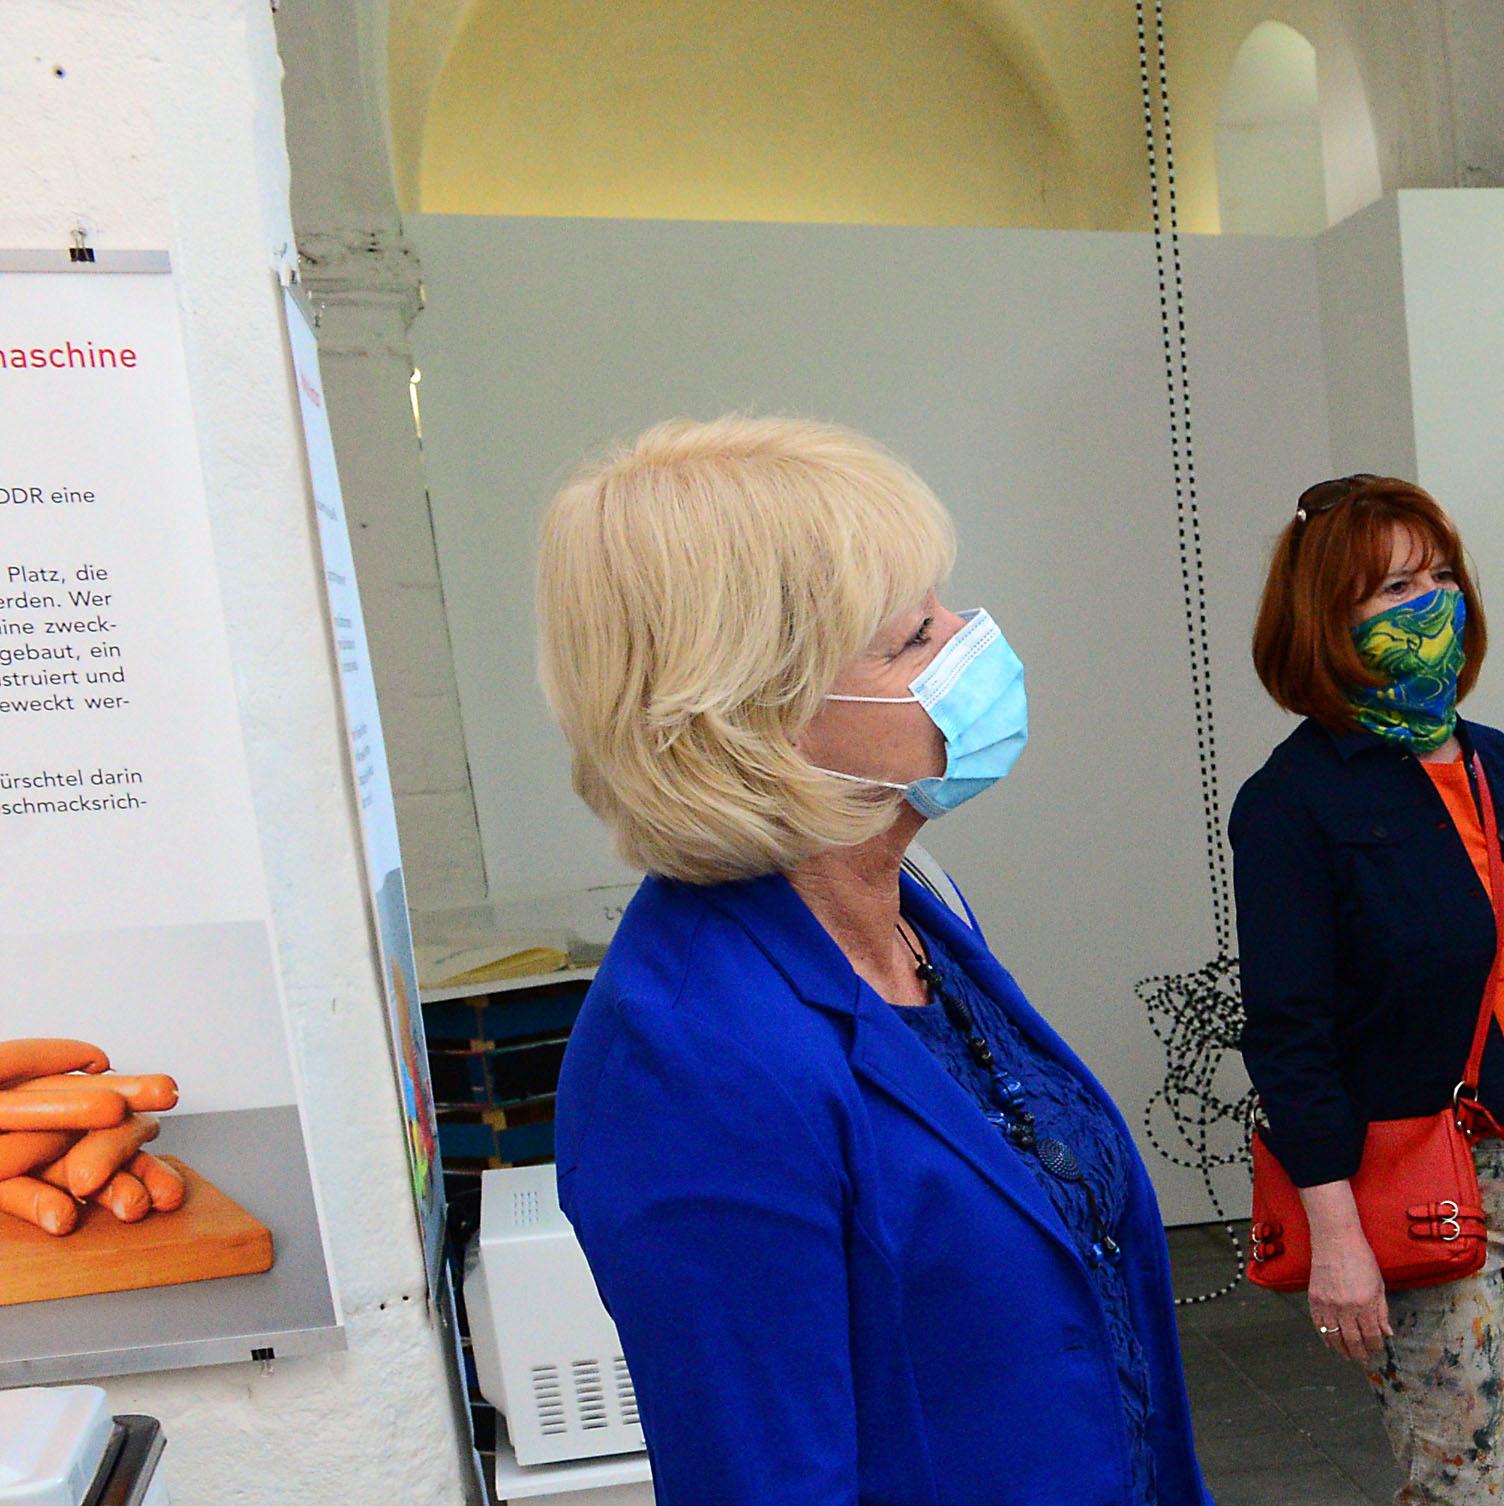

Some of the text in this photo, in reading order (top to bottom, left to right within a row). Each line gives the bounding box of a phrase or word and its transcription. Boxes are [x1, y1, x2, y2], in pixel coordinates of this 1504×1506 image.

[51, 486, 96, 503] eine
[8, 564, 108, 584] Platz, die
[68, 591, 112, 607] Wer
[0, 616, 118, 634] ine zweck-
[0, 641, 122, 666] gebaut, ein
[0, 666, 126, 687] struiert und
[84, 696, 130, 709] wer-
[90, 768, 143, 786] darin
[1, 792, 148, 815] schmacksrich-
